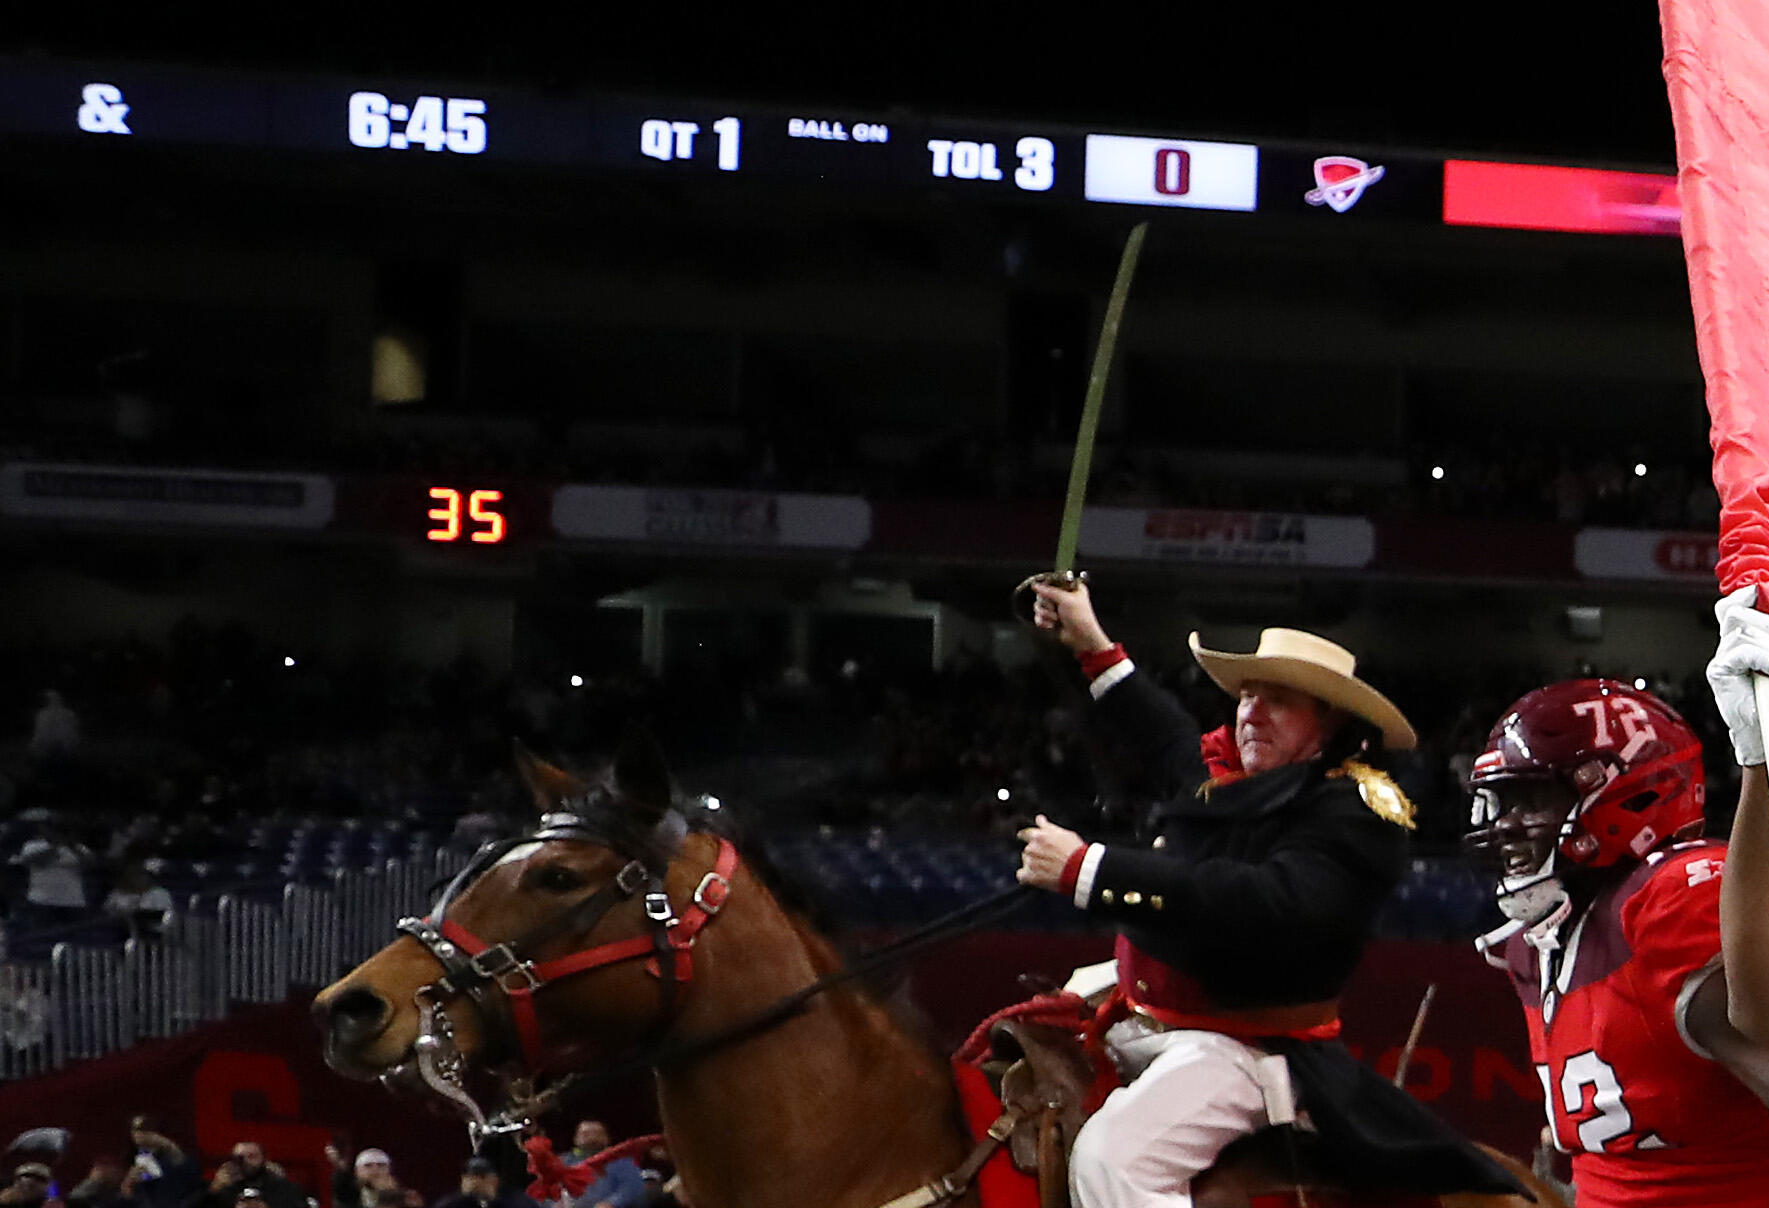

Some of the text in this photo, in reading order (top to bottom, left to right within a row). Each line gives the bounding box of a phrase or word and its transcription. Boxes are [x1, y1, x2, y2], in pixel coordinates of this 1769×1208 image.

[78, 83, 132, 136] &
[348, 92, 489, 154] 6:45
[788, 119, 889, 144] BALL ON
[641, 118, 741, 172] QT 1
[928, 137, 1056, 192] TOL 3
[1154, 148, 1192, 197] 0
[427, 487, 508, 546] 35
[1572, 697, 1657, 758] 72
